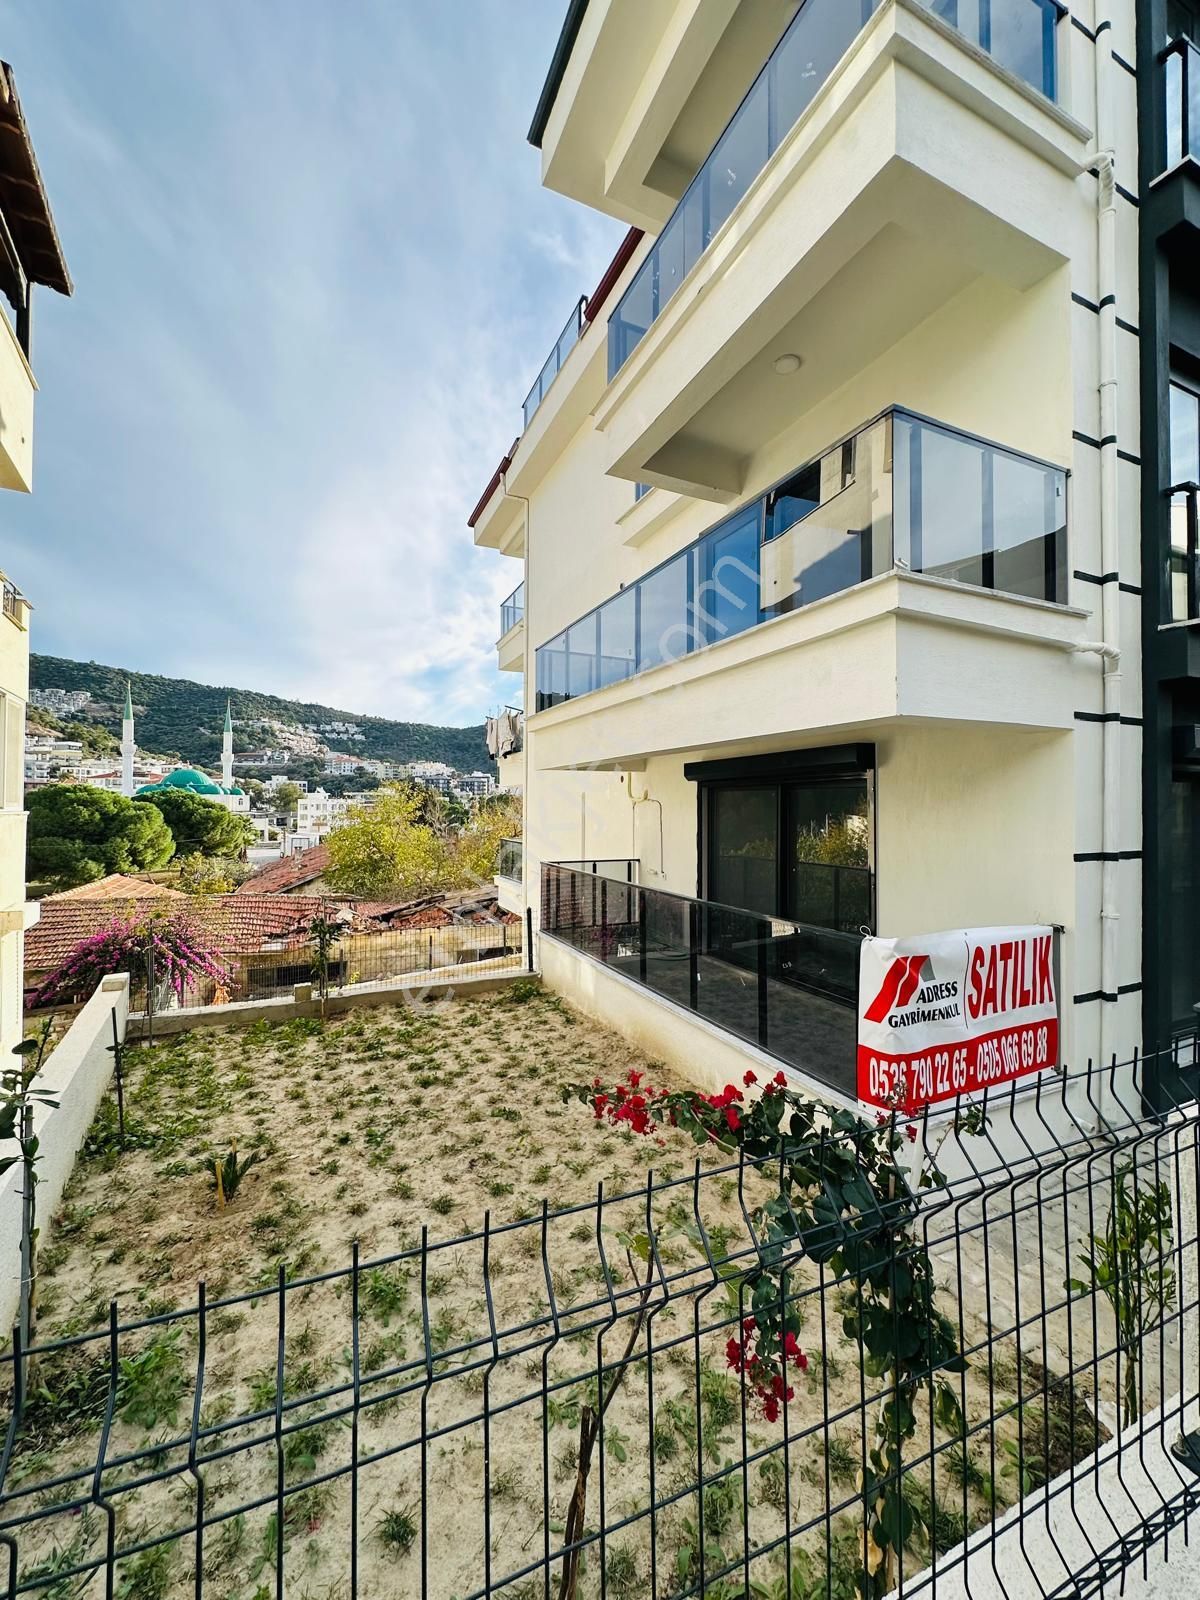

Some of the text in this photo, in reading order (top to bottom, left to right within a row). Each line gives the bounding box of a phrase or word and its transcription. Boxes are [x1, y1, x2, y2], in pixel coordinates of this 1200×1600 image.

[916, 981, 958, 1004] ADRESS
[968, 935, 1054, 1019] SATILIK
[888, 1003, 960, 1028] GAYRİMENKUL
[911, 1055, 934, 1100] 790
[935, 1051, 951, 1094] 22
[952, 1049, 967, 1087] 65
[977, 1038, 1002, 1082] 0505
[1001, 1032, 1020, 1075] 066
[1021, 1029, 1035, 1068] 69
[1036, 1025, 1048, 1064] 88
